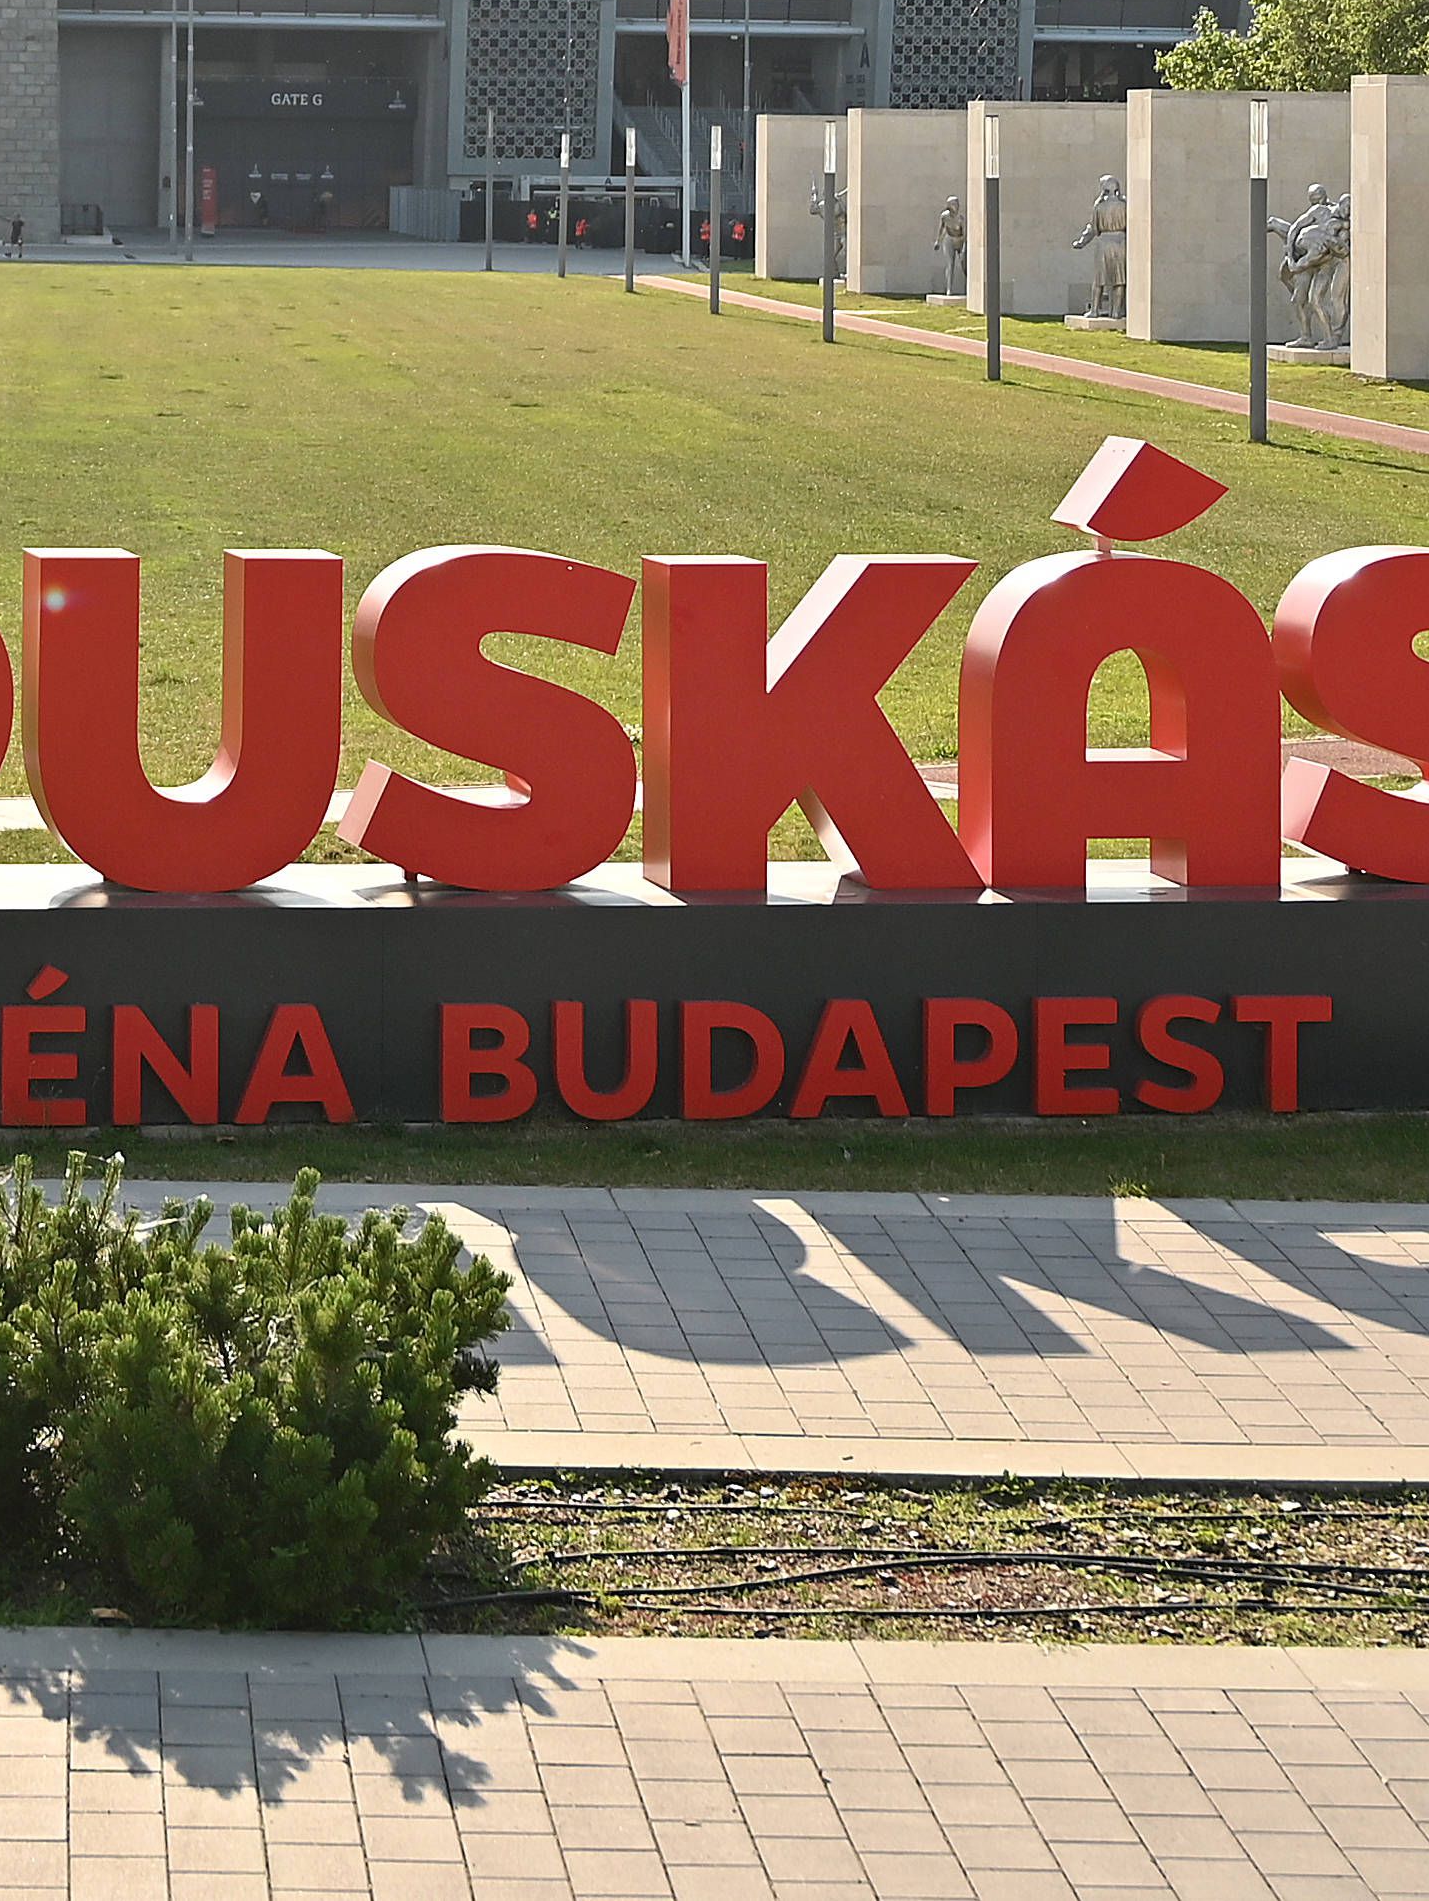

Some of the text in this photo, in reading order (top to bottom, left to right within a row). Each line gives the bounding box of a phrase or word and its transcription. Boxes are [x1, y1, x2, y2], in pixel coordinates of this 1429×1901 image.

[860, 42, 871, 69] A
[271, 92, 323, 106] GATE G
[439, 992, 1334, 1127] BUDAPEST
